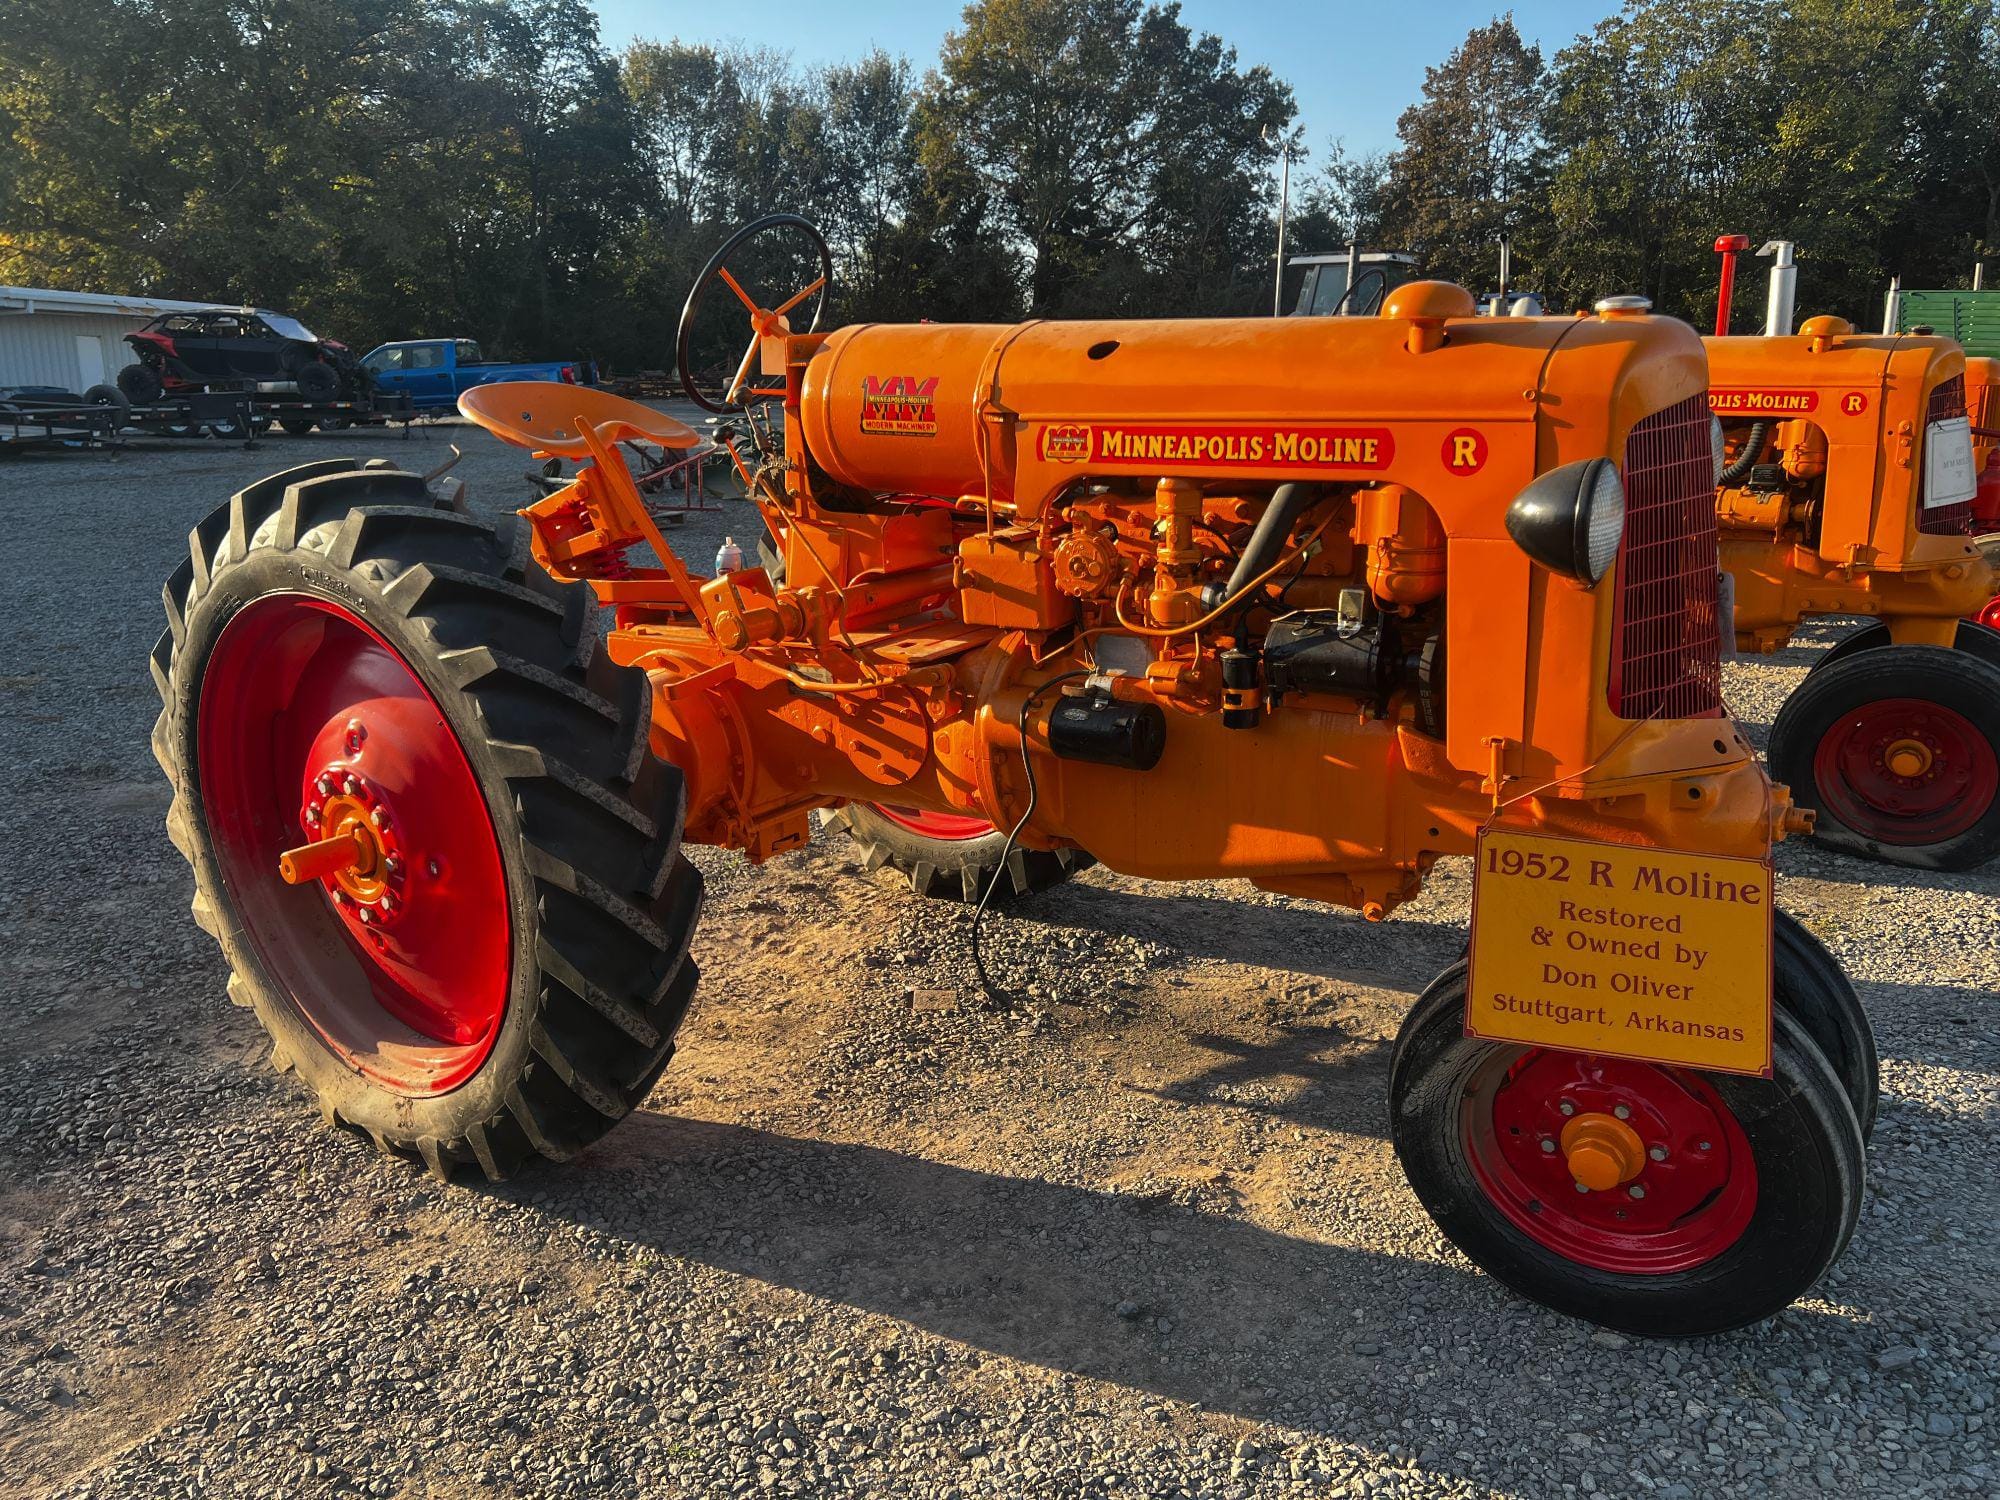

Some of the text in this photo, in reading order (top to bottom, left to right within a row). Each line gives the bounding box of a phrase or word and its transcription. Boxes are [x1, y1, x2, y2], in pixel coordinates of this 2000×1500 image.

[1847, 395, 1862, 411] R
[865, 421, 935, 432] MODERN MACHINERY
[1453, 436, 1478, 467] R
[1486, 848, 1762, 905] 1952 R Moline
[1559, 901, 1683, 934] Restored
[1530, 926, 1709, 970] & Owned by
[1542, 964, 1695, 1001] Don Oliver
[1492, 993, 1745, 1042] Stuttgart, Arkansas
